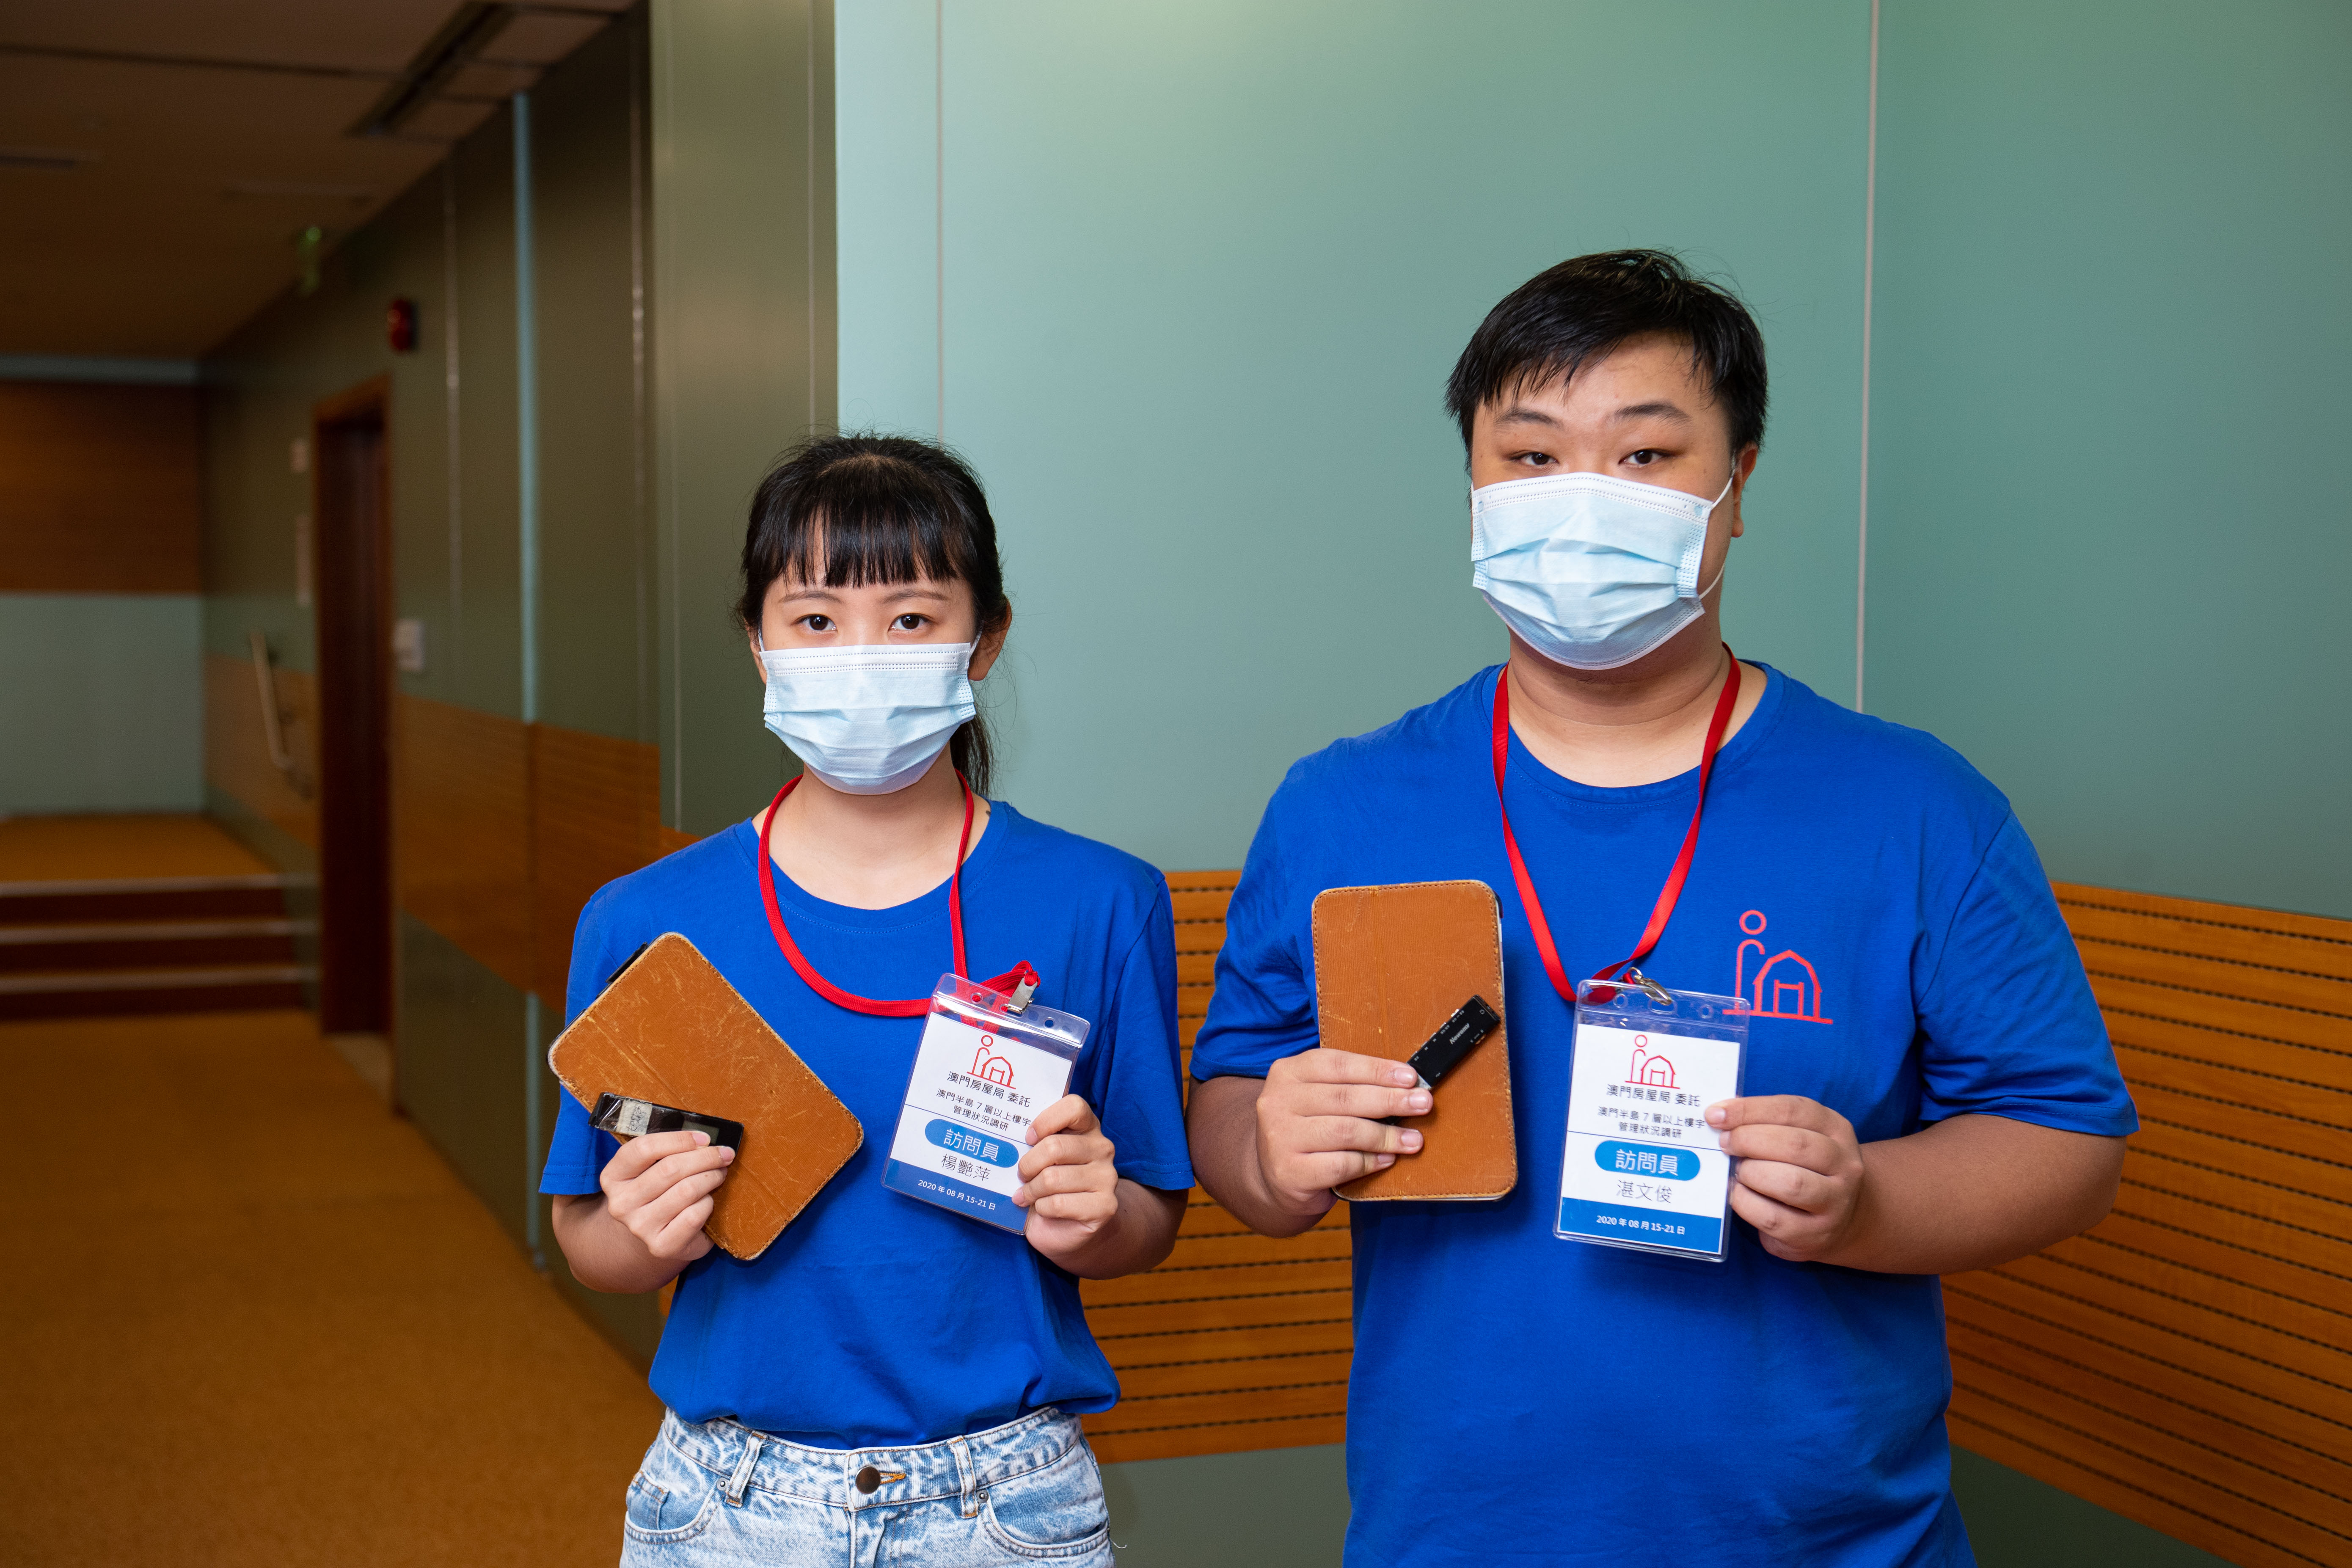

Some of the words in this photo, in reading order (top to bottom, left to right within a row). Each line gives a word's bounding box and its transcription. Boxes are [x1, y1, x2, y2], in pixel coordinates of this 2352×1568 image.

[947, 1071, 1004, 1099] 澳門房屋局
[1007, 1092, 1031, 1108] 委託
[1606, 1084, 1671, 1103] 澳門房屋局
[1674, 1093, 1701, 1107] 委託
[936, 1088, 974, 1108] 澳門半島
[977, 1102, 983, 1110] 7
[983, 1104, 1031, 1127] 層以上樓宇
[953, 1105, 1009, 1131] 管理狀況調研
[1597, 1106, 1639, 1120] 澳門半島
[1643, 1112, 1649, 1121] 7
[1652, 1113, 1705, 1129] 層以上樓宇
[1618, 1122, 1682, 1138] 管理狀況調研
[943, 1128, 999, 1162] 訪問員
[941, 1153, 991, 1181] 楊艷萍
[1615, 1149, 1678, 1176] 訪問員
[917, 1179, 936, 1190] 2020
[938, 1185, 945, 1193] 年
[946, 1189, 956, 1197] 08
[957, 1192, 964, 1201] 月
[966, 1196, 986, 1207] 15-21
[1616, 1179, 1673, 1203] 湛文俊
[1596, 1215, 1617, 1226] 2020
[1618, 1218, 1627, 1227] 年
[1628, 1219, 1639, 1229] 08
[1640, 1221, 1649, 1230] 月
[1651, 1223, 1675, 1234] 15-21
[1677, 1226, 1686, 1235] 日
